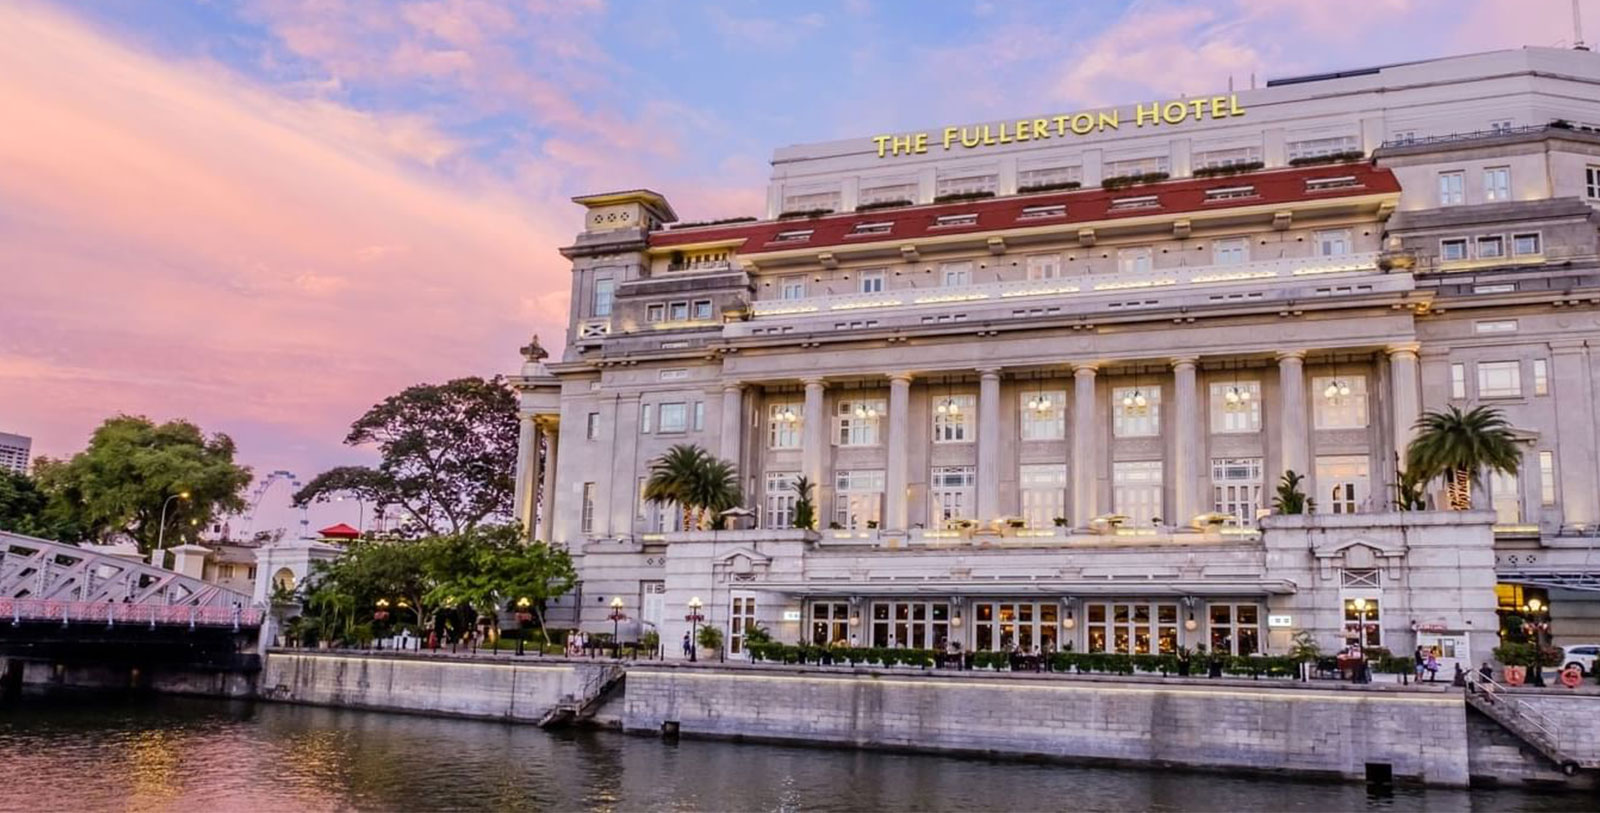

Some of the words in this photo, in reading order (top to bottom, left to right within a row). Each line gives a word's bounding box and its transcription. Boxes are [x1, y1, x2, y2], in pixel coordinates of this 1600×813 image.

[873, 133, 928, 157] THE
[943, 109, 1119, 149] FULLERTON
[1136, 94, 1245, 127] HOTEL
